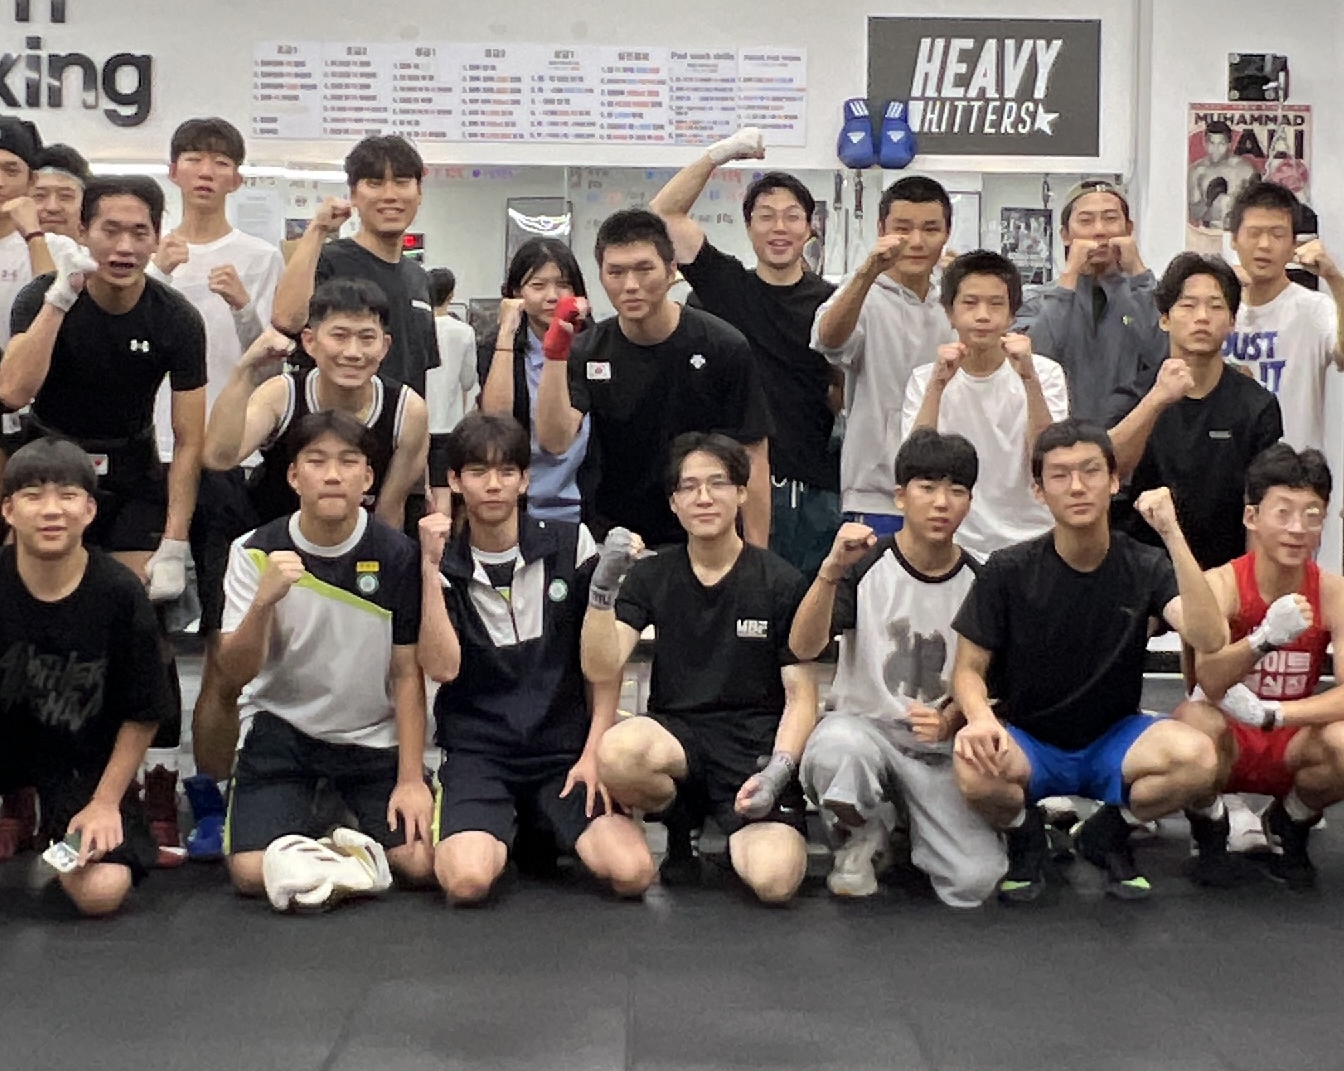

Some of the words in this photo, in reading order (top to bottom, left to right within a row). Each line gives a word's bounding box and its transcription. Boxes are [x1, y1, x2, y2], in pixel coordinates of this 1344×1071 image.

[911, 37, 1063, 99] HEAVY
[922, 100, 1035, 134] HITTERS
[1194, 112, 1305, 126] MUHAMMAD
[1221, 331, 1278, 360] JUST
